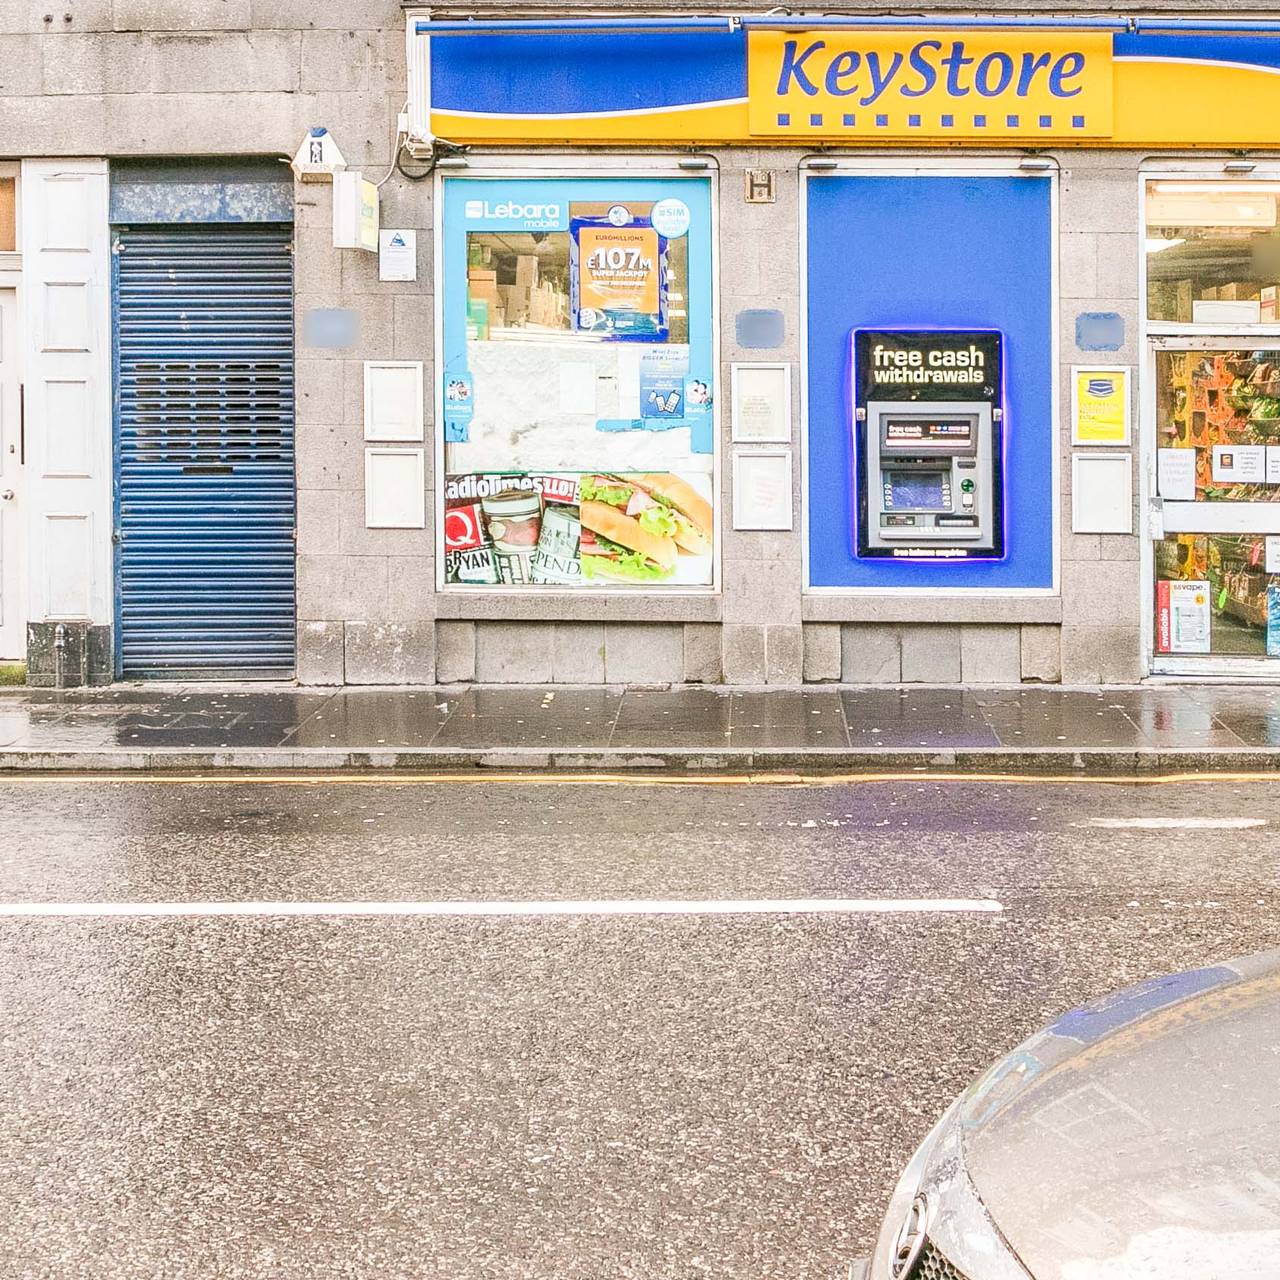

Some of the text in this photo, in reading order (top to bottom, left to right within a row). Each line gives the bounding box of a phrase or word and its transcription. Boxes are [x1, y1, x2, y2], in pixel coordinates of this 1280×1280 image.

[776, 39, 1085, 107] KeyStore
[484, 200, 560, 219] Lebara
[523, 219, 560, 228] mobile
[595, 234, 644, 242] EUROMILLIONS
[588, 247, 651, 270] £107M
[615, 269, 649, 277] JACKPOT
[873, 346, 984, 366] free cash
[873, 366, 984, 383] withdrawals
